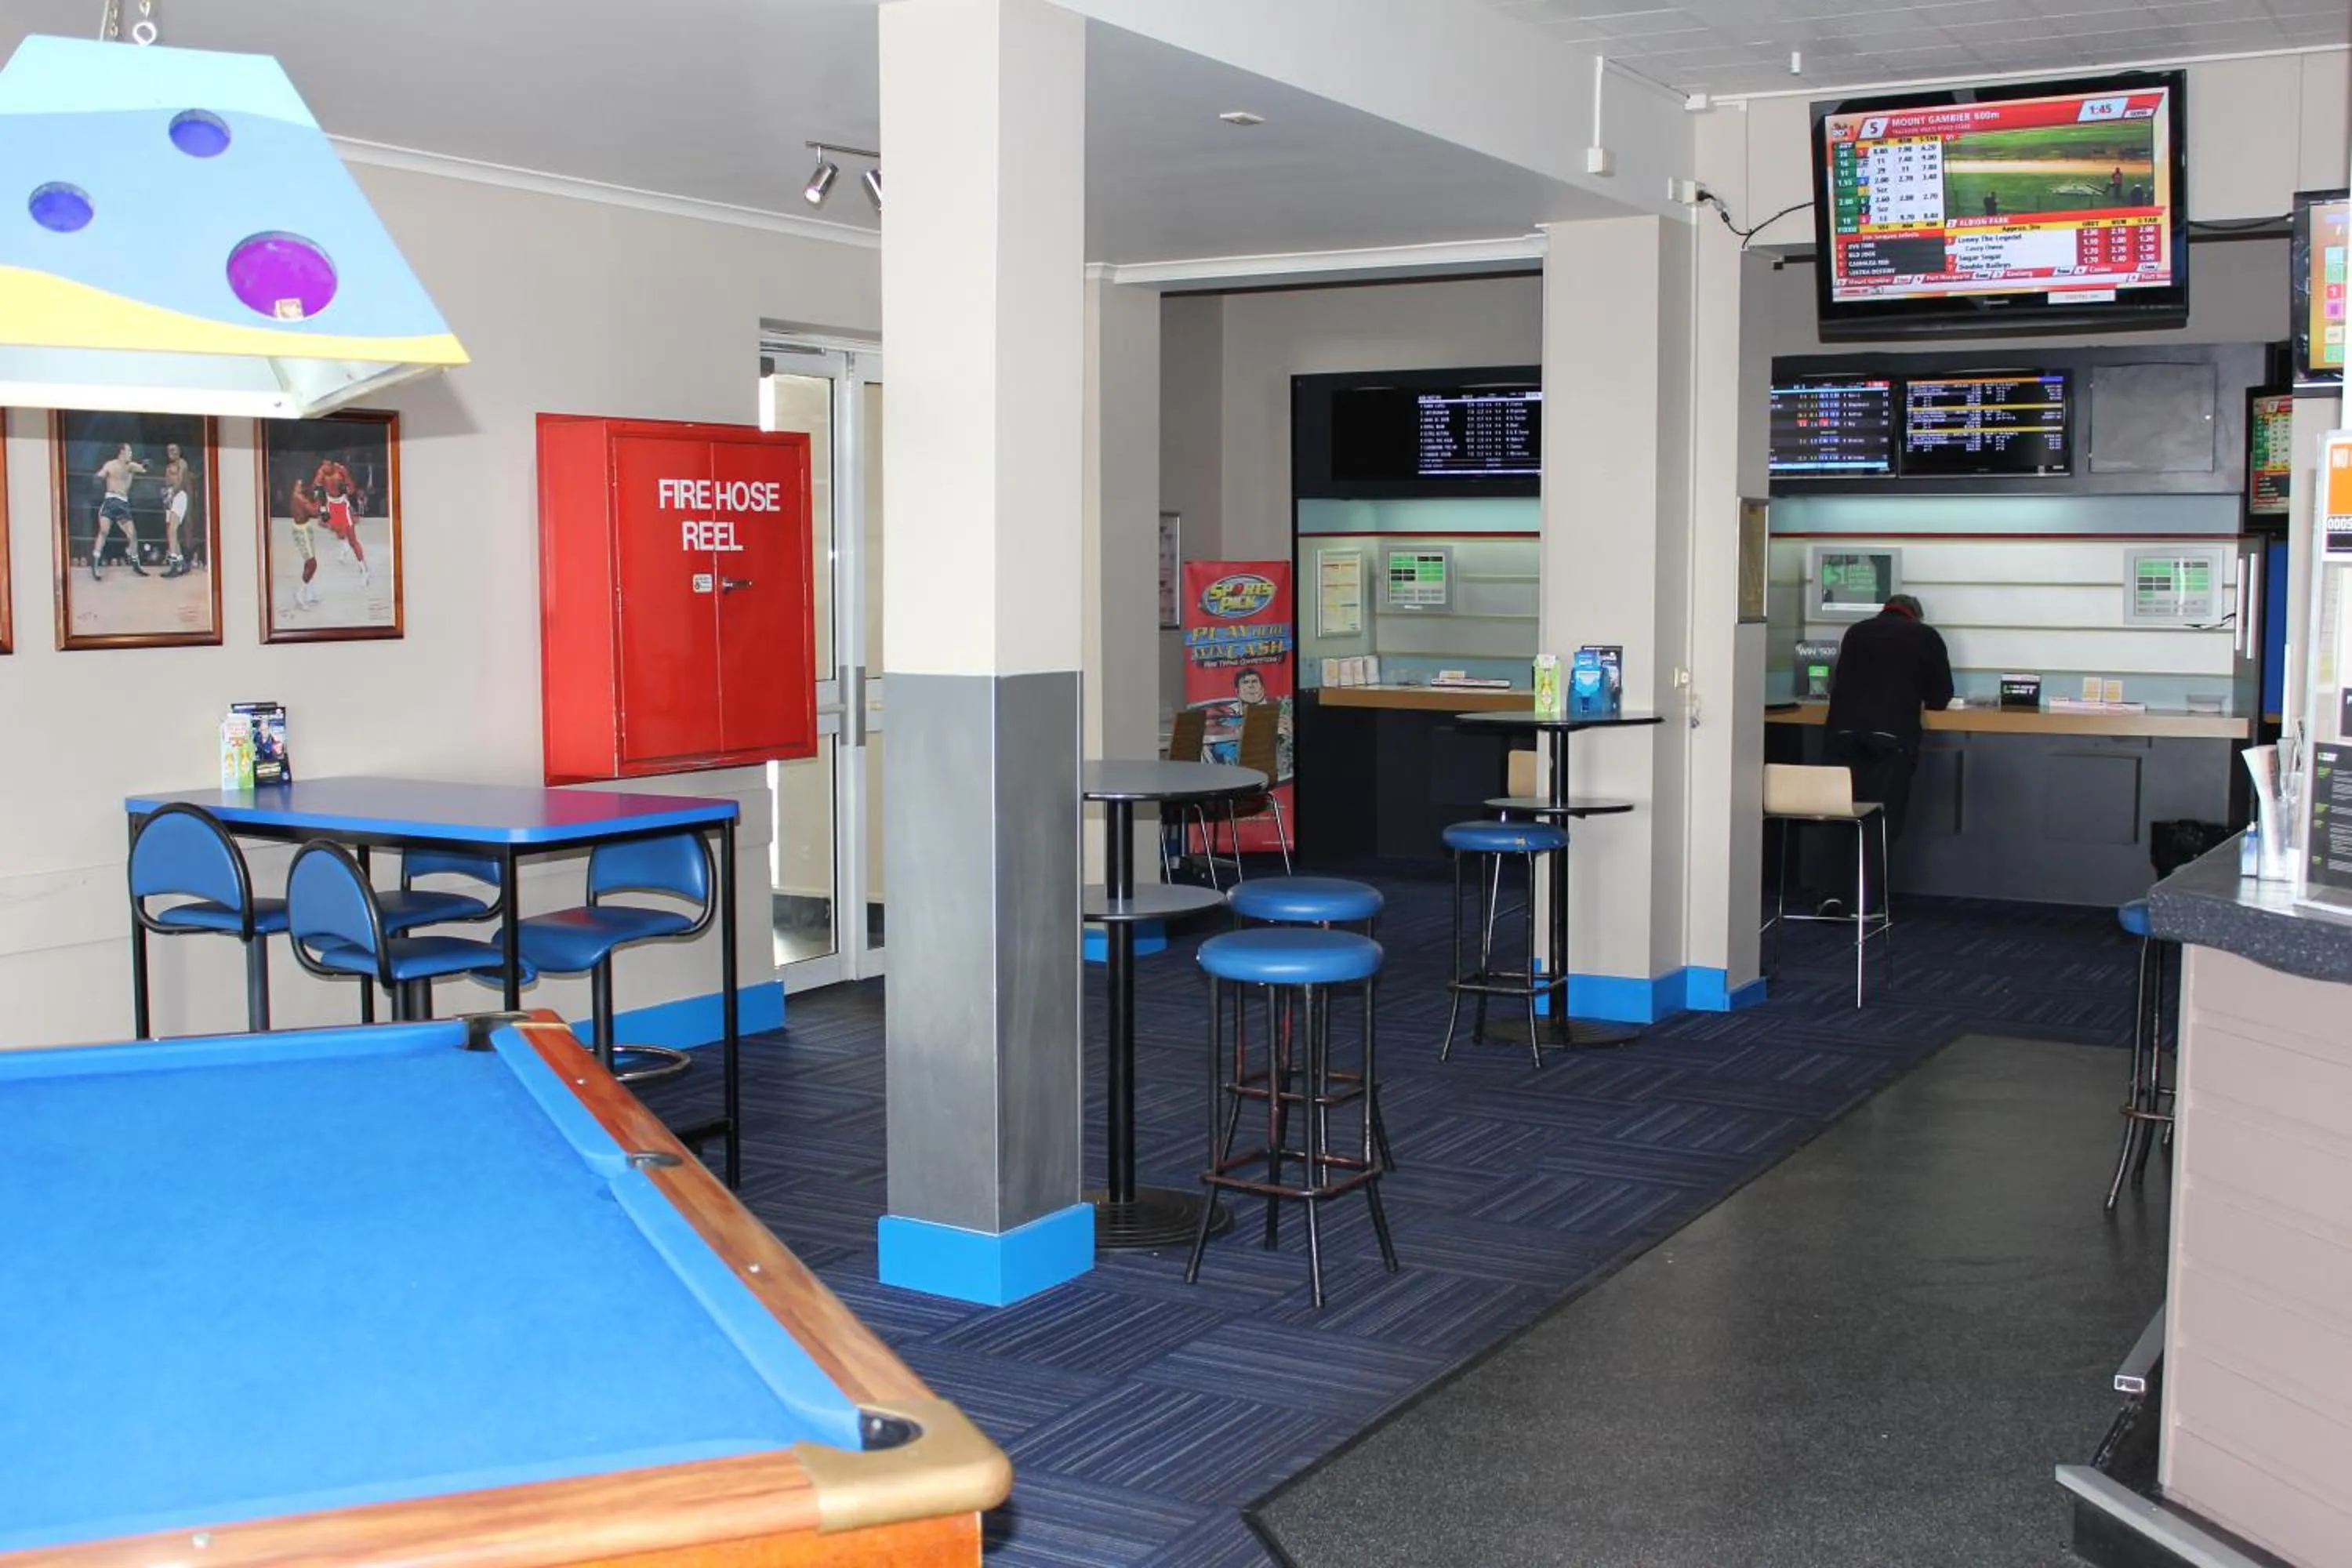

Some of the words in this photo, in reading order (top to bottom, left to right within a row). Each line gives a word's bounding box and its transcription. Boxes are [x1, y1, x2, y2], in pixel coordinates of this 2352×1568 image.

[2089, 103, 2112, 114] 1:45
[1892, 117, 1926, 126] MOUNT
[1928, 114, 1970, 124] GAMBIER
[1869, 122, 1878, 135] 5
[659, 479, 712, 509] FIRE
[715, 481, 781, 512] HOSE
[682, 521, 744, 551] REEL
